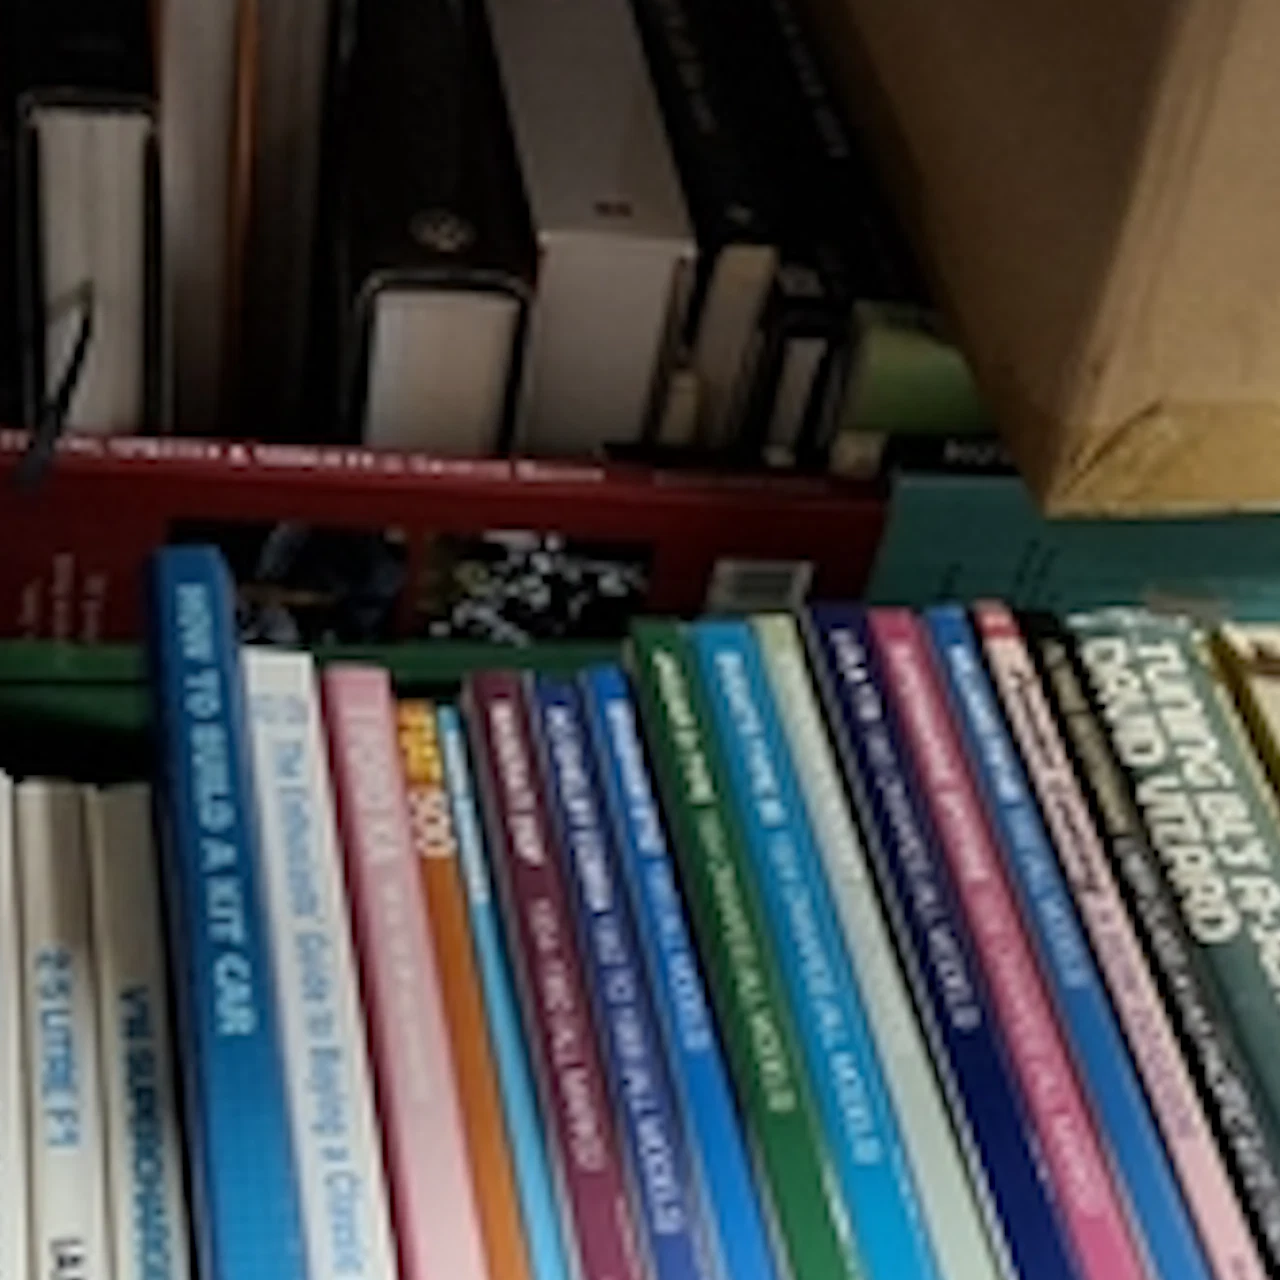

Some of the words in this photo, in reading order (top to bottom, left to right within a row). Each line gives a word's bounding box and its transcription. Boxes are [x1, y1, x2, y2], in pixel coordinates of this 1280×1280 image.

[174, 579, 218, 664] HOW
[181, 669, 223, 718] TO
[1130, 631, 1237, 799] TUNING
[188, 722, 234, 832] BUILD
[1075, 630, 1169, 774] DAVID
[1130, 768, 1245, 954] VIZARD
[200, 835, 239, 872] A
[202, 873, 247, 950] KIT
[209, 953, 257, 1039] CAR
[292, 928, 338, 1002] Guide
[306, 1009, 337, 1040] to
[302, 1043, 350, 1137] Buying
[324, 1168, 373, 1277] Classic
